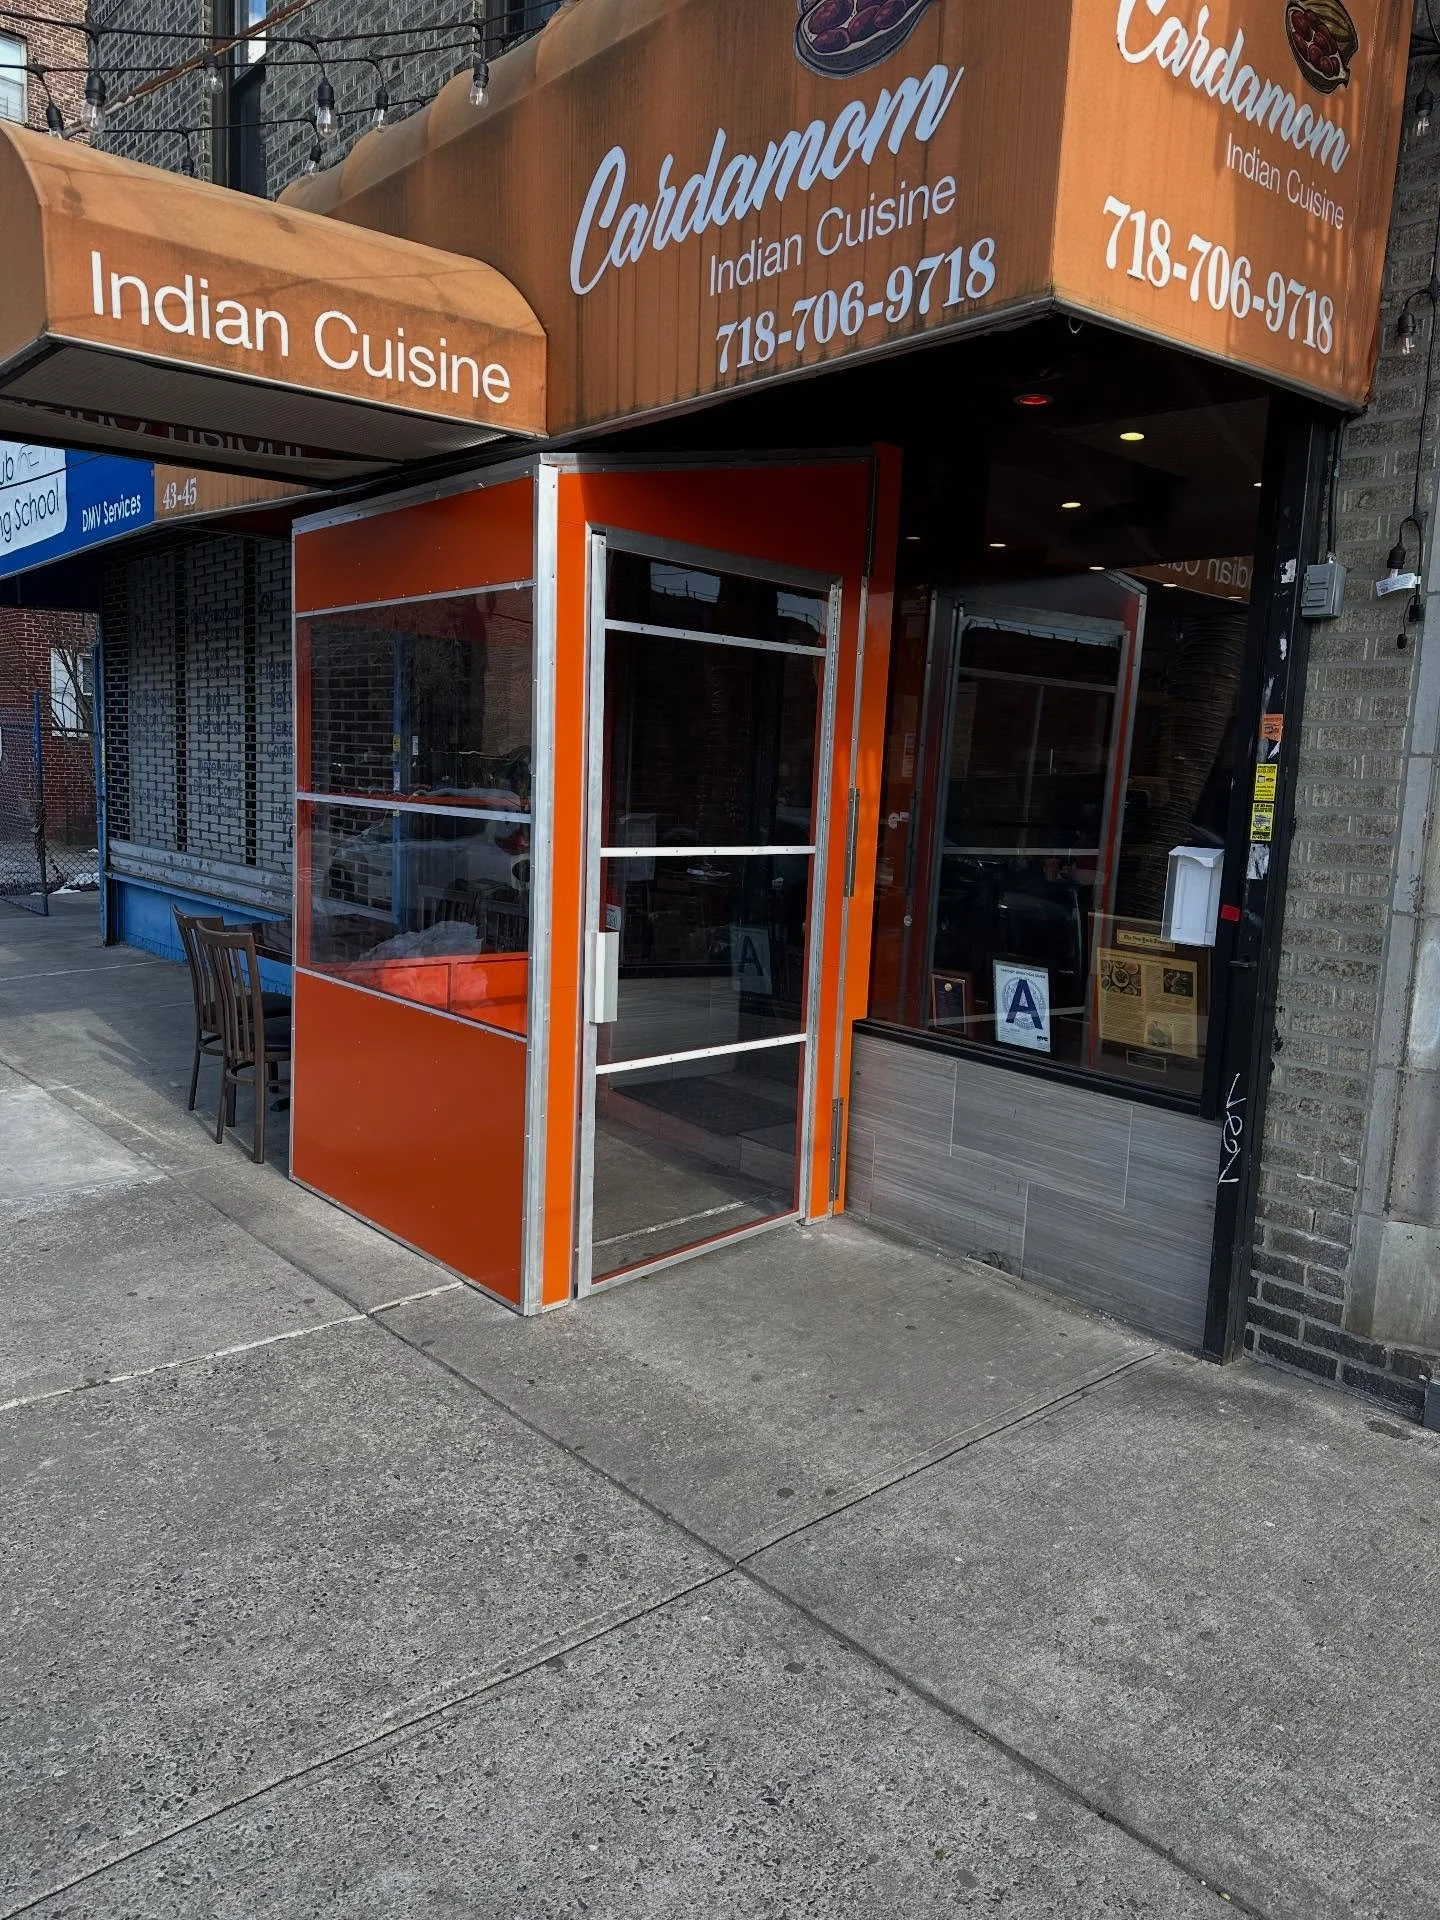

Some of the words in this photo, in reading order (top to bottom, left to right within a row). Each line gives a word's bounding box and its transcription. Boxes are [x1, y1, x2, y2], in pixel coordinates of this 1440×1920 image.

[1115, 0, 1351, 173] Cardamom
[570, 64, 965, 296] Cardamom
[708, 233, 803, 297] Indian
[815, 174, 957, 256] Cuisine
[1224, 132, 1281, 194] Indian
[1286, 169, 1345, 231] Cuisine
[90, 250, 290, 358] Indian
[313, 309, 512, 405] Cuisine
[715, 236, 997, 375] 718-706-9718
[1102, 194, 1335, 355] 718-706-9718
[14, 477, 60, 532] School
[82, 503, 102, 533] DMV
[103, 493, 142, 526] Services
[162, 475, 198, 511] 43-45
[1005, 979, 1043, 1030] A
